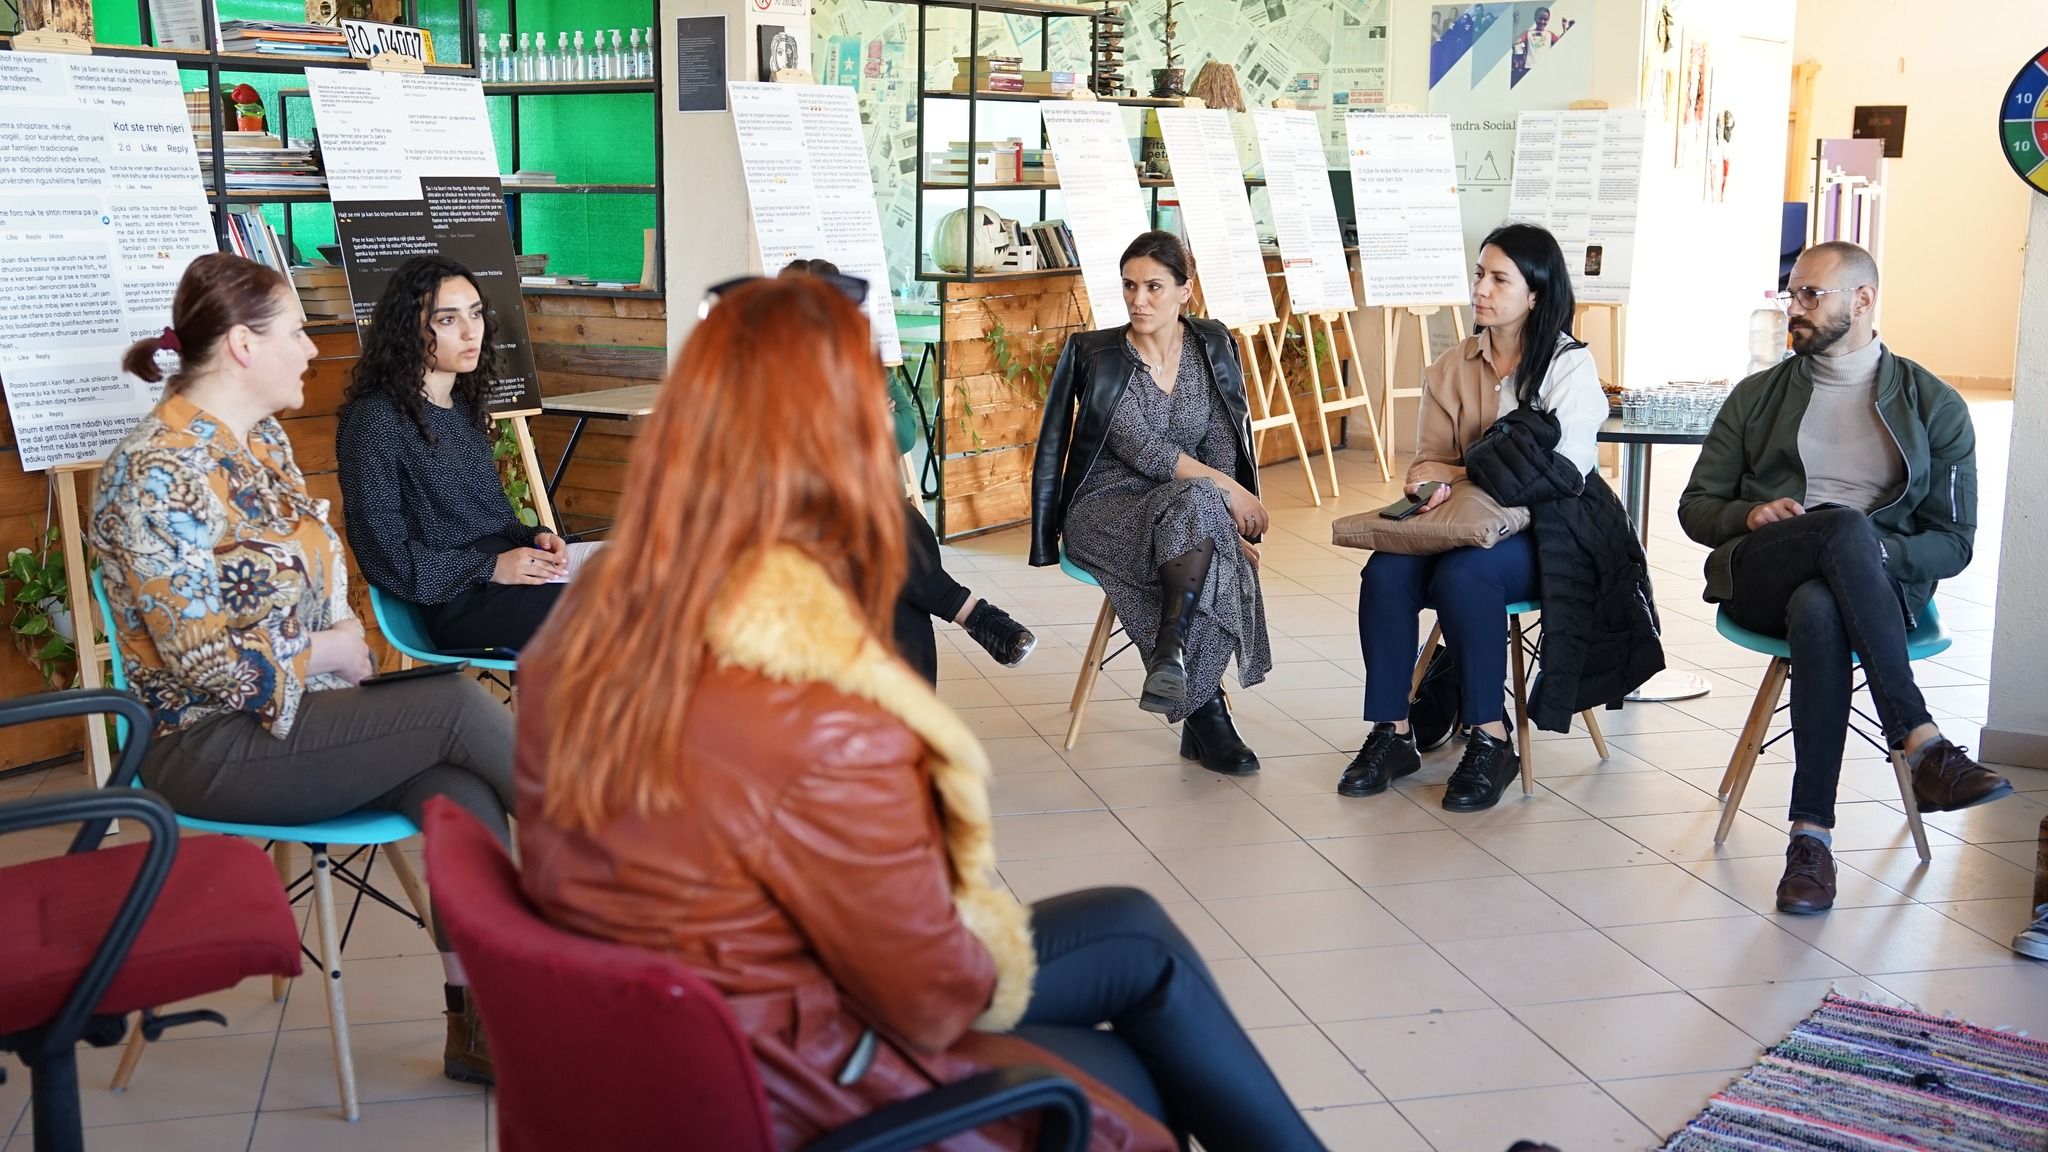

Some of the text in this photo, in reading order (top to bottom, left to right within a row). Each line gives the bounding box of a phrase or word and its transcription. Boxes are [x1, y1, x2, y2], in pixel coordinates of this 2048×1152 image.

[345, 24, 371, 55] RO
[2016, 93, 2032, 104] 10
[113, 122, 185, 134] Kot ste rreh njeri
[1482, 120, 1516, 131] Social
[141, 144, 158, 152] Like
[167, 144, 188, 155] Reply
[2013, 141, 2030, 152] 10
[18, 426, 38, 434] Shum
[82, 420, 102, 428] ndodh
[103, 418, 113, 427] kjo
[114, 418, 126, 426] veq
[32, 434, 44, 443] dal
[45, 433, 58, 443] gati
[22, 446, 40, 454] edhe
[87, 440, 98, 448] par
[46, 452, 62, 462] qysh
